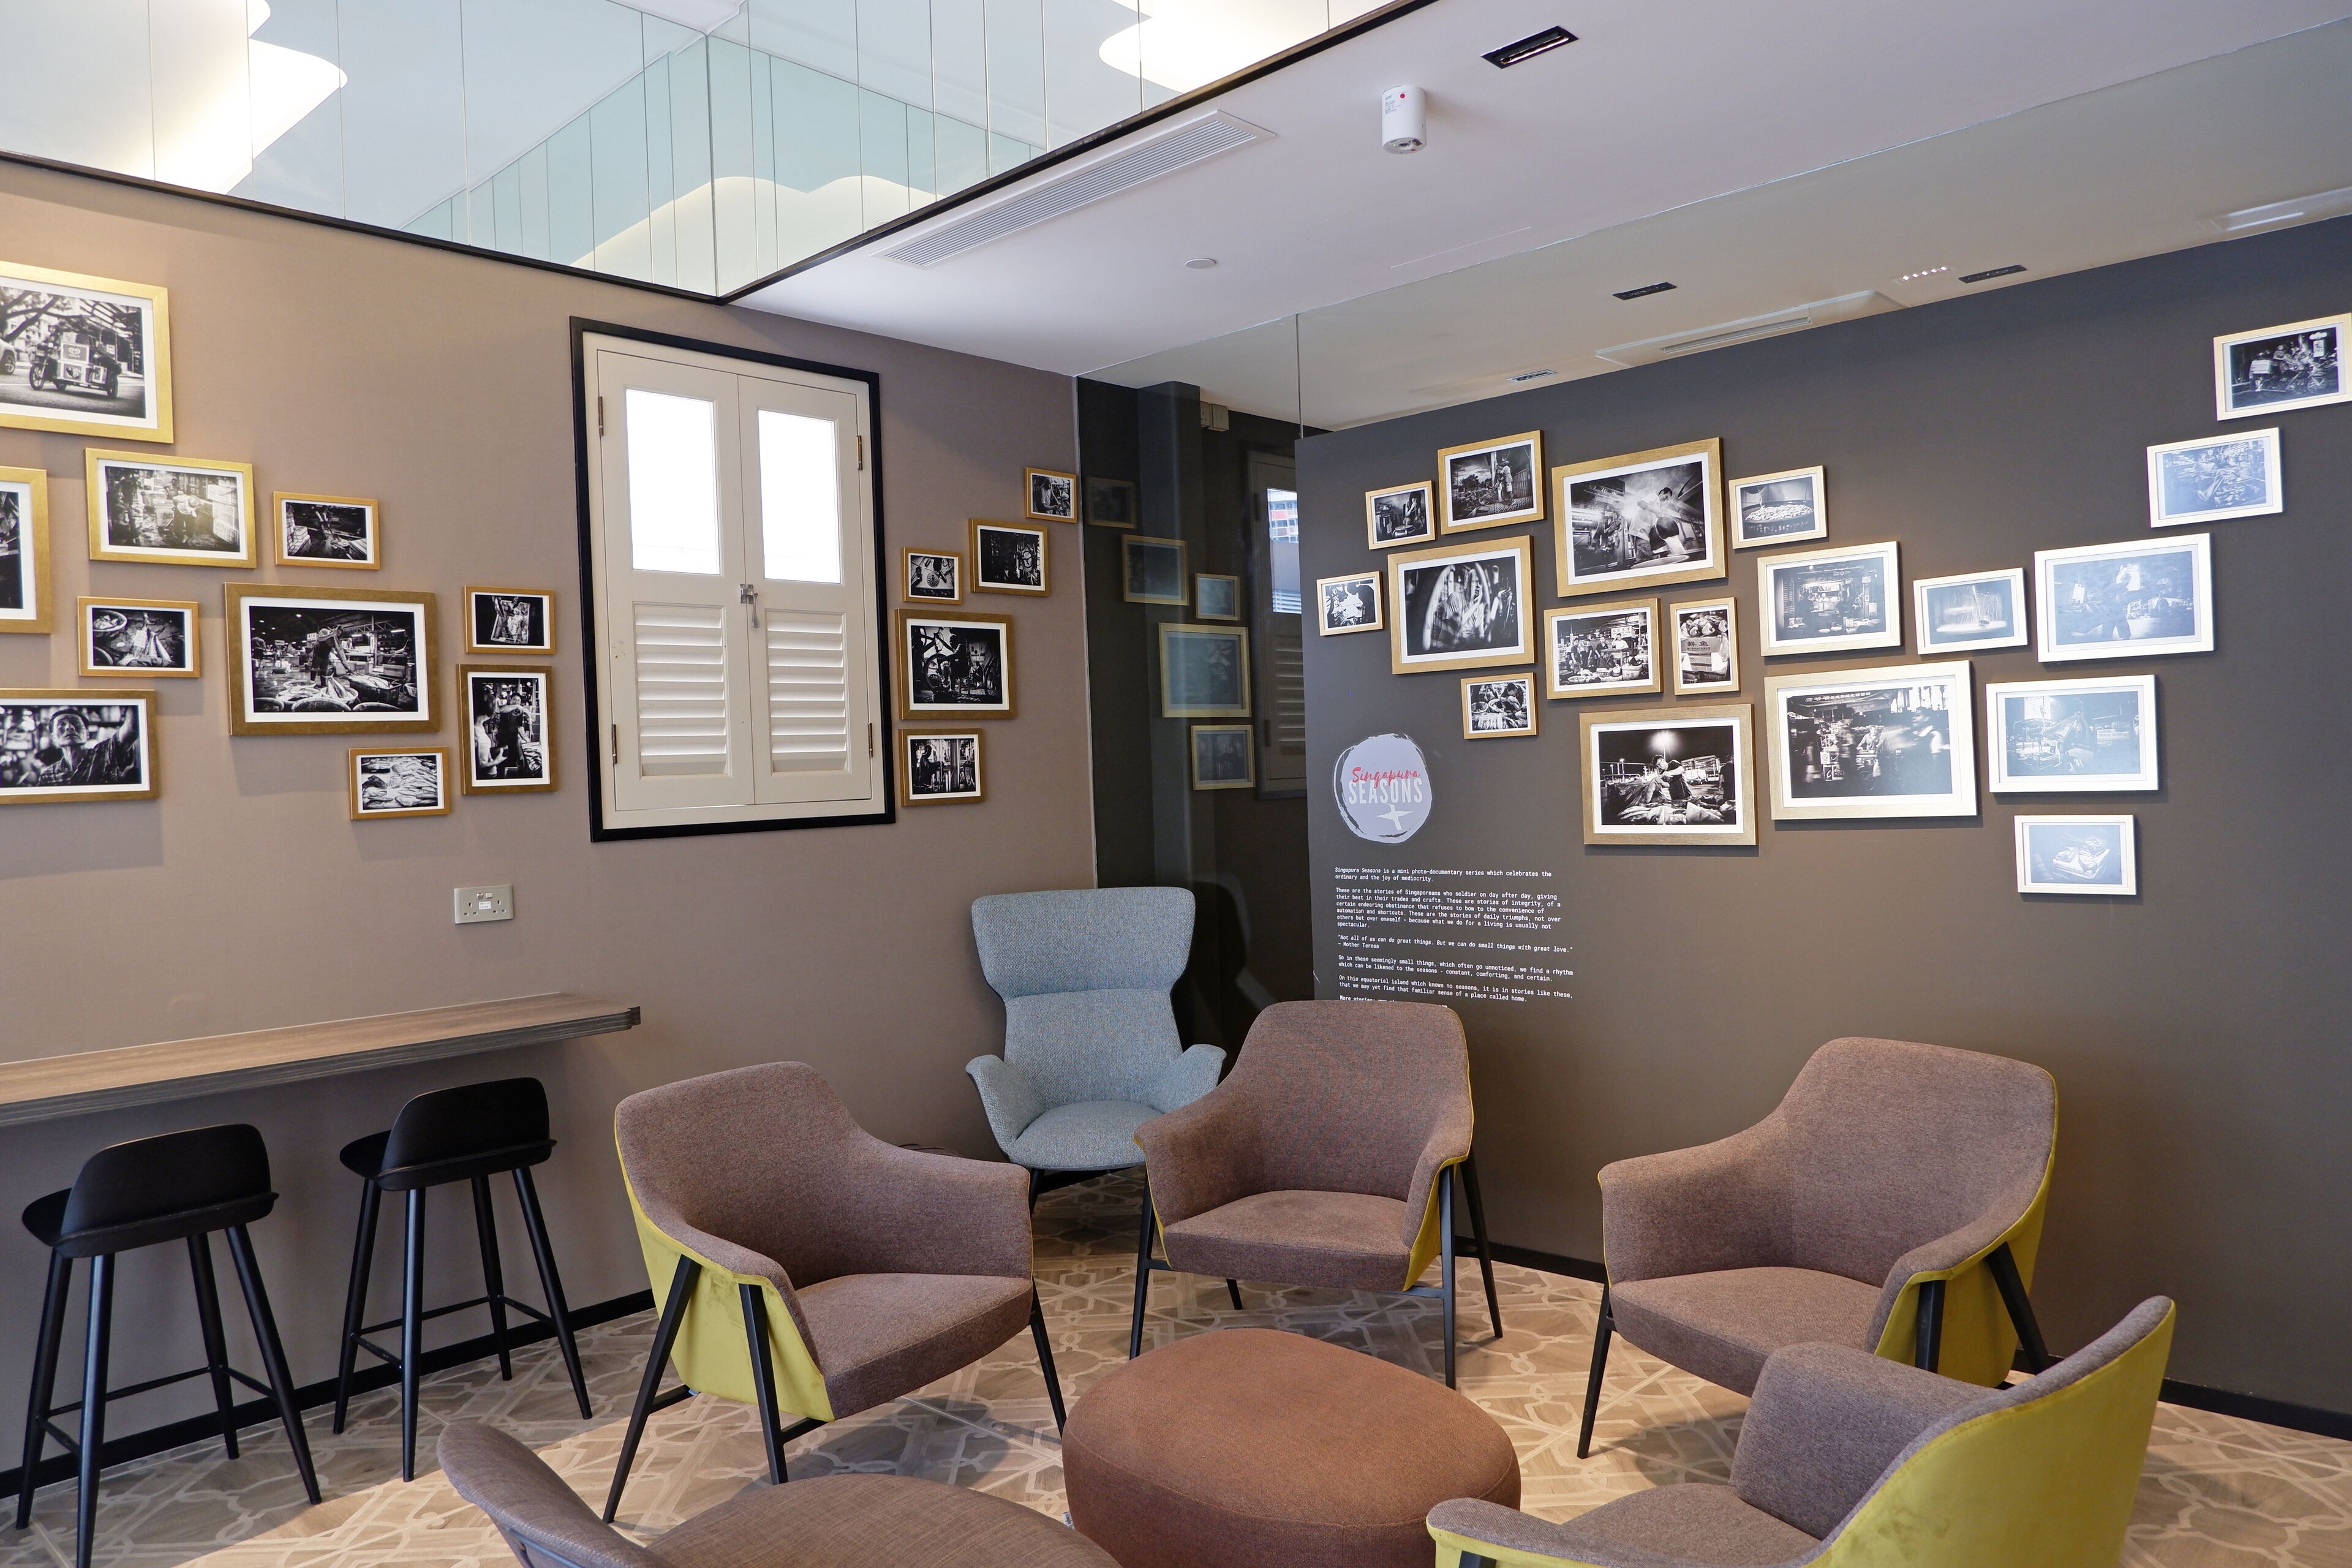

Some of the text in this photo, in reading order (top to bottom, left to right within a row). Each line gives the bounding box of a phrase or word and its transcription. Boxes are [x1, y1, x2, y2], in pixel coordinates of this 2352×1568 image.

[1352, 766, 1420, 789] Singapura
[1348, 777, 1423, 804] SEASONS
[1411, 868, 1463, 876] photo-documentary
[1511, 899, 1544, 908] integrity,
[1483, 913, 1500, 922] daily
[1502, 914, 1531, 924] triumphs,
[1483, 919, 1504, 929] living
[1416, 959, 1437, 968] things,
[1553, 968, 1574, 976] rhythm
[1476, 971, 1510, 980] comforting,
[1553, 990, 1573, 999] these,
